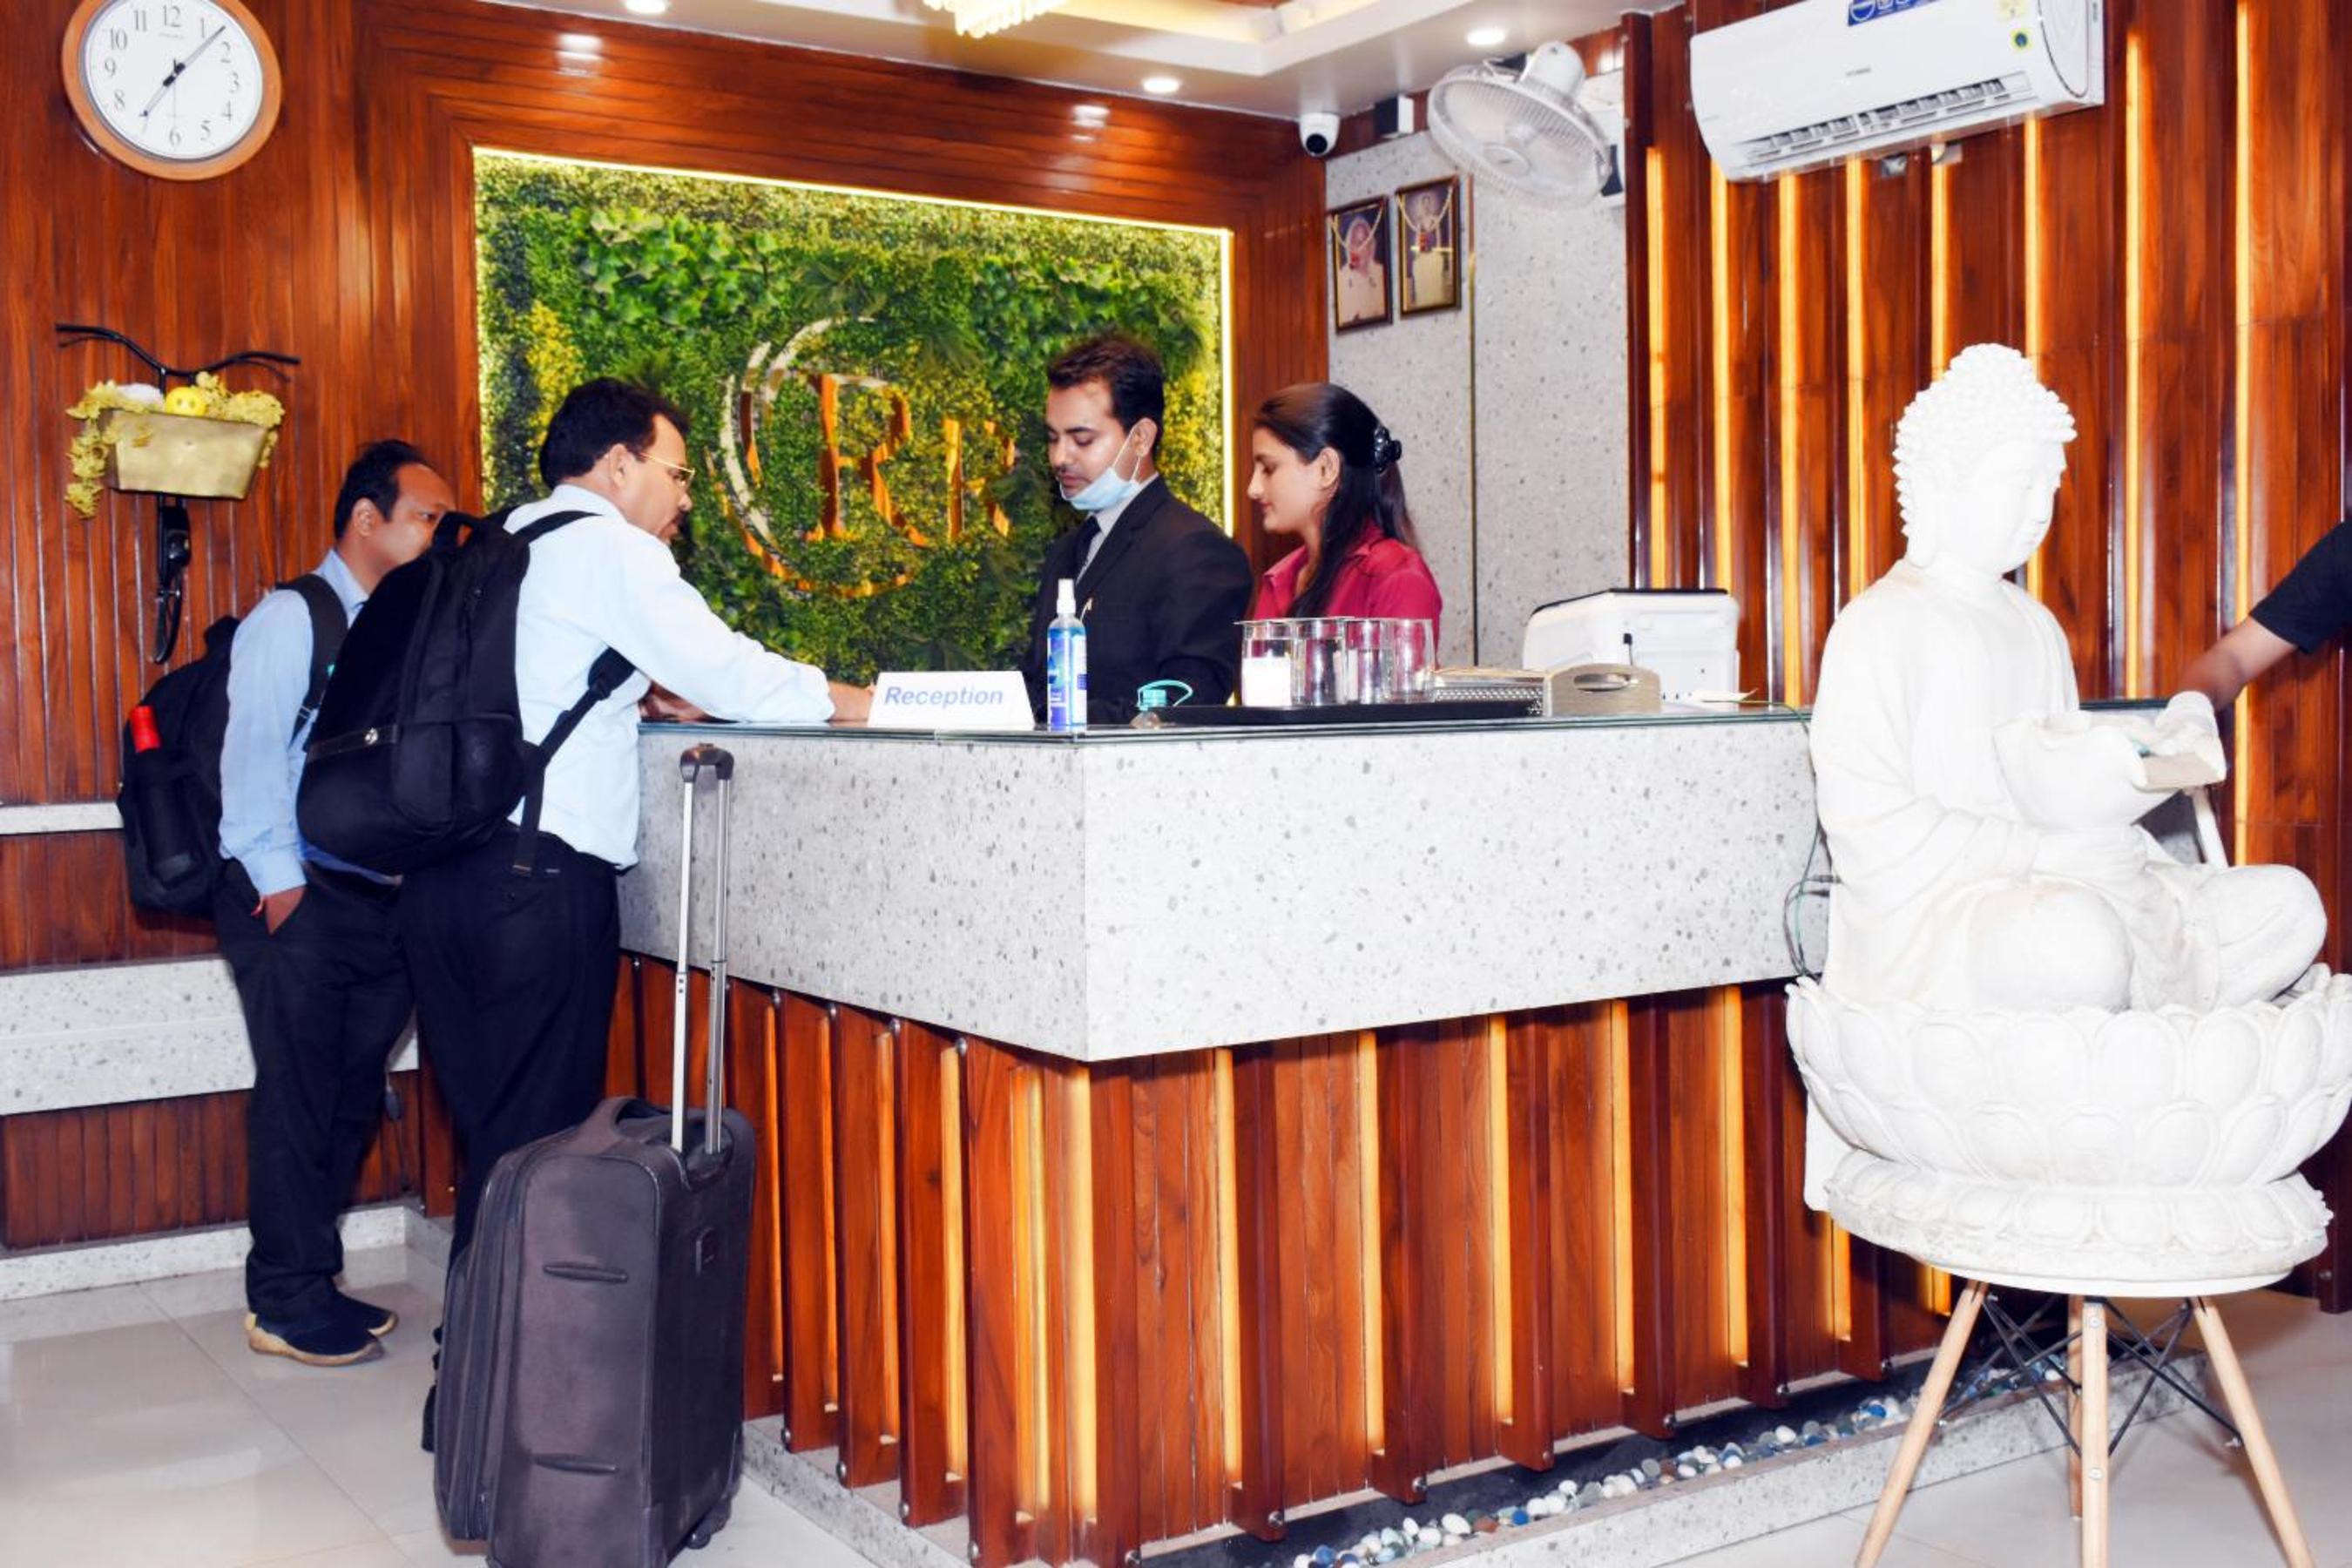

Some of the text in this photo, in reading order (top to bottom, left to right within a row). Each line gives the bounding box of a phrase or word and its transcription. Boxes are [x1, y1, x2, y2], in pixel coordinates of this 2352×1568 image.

[134, 10, 146, 31] 11
[163, 4, 181, 27] 12
[110, 28, 128, 50] 10
[220, 41, 231, 64] 2
[105, 57, 115, 77] 9
[230, 71, 240, 93] 3
[114, 90, 125, 110] 8
[221, 101, 232, 121] 4
[169, 128, 181, 146] 6
[200, 119, 211, 141] 5
[884, 686, 1004, 708] Reception
